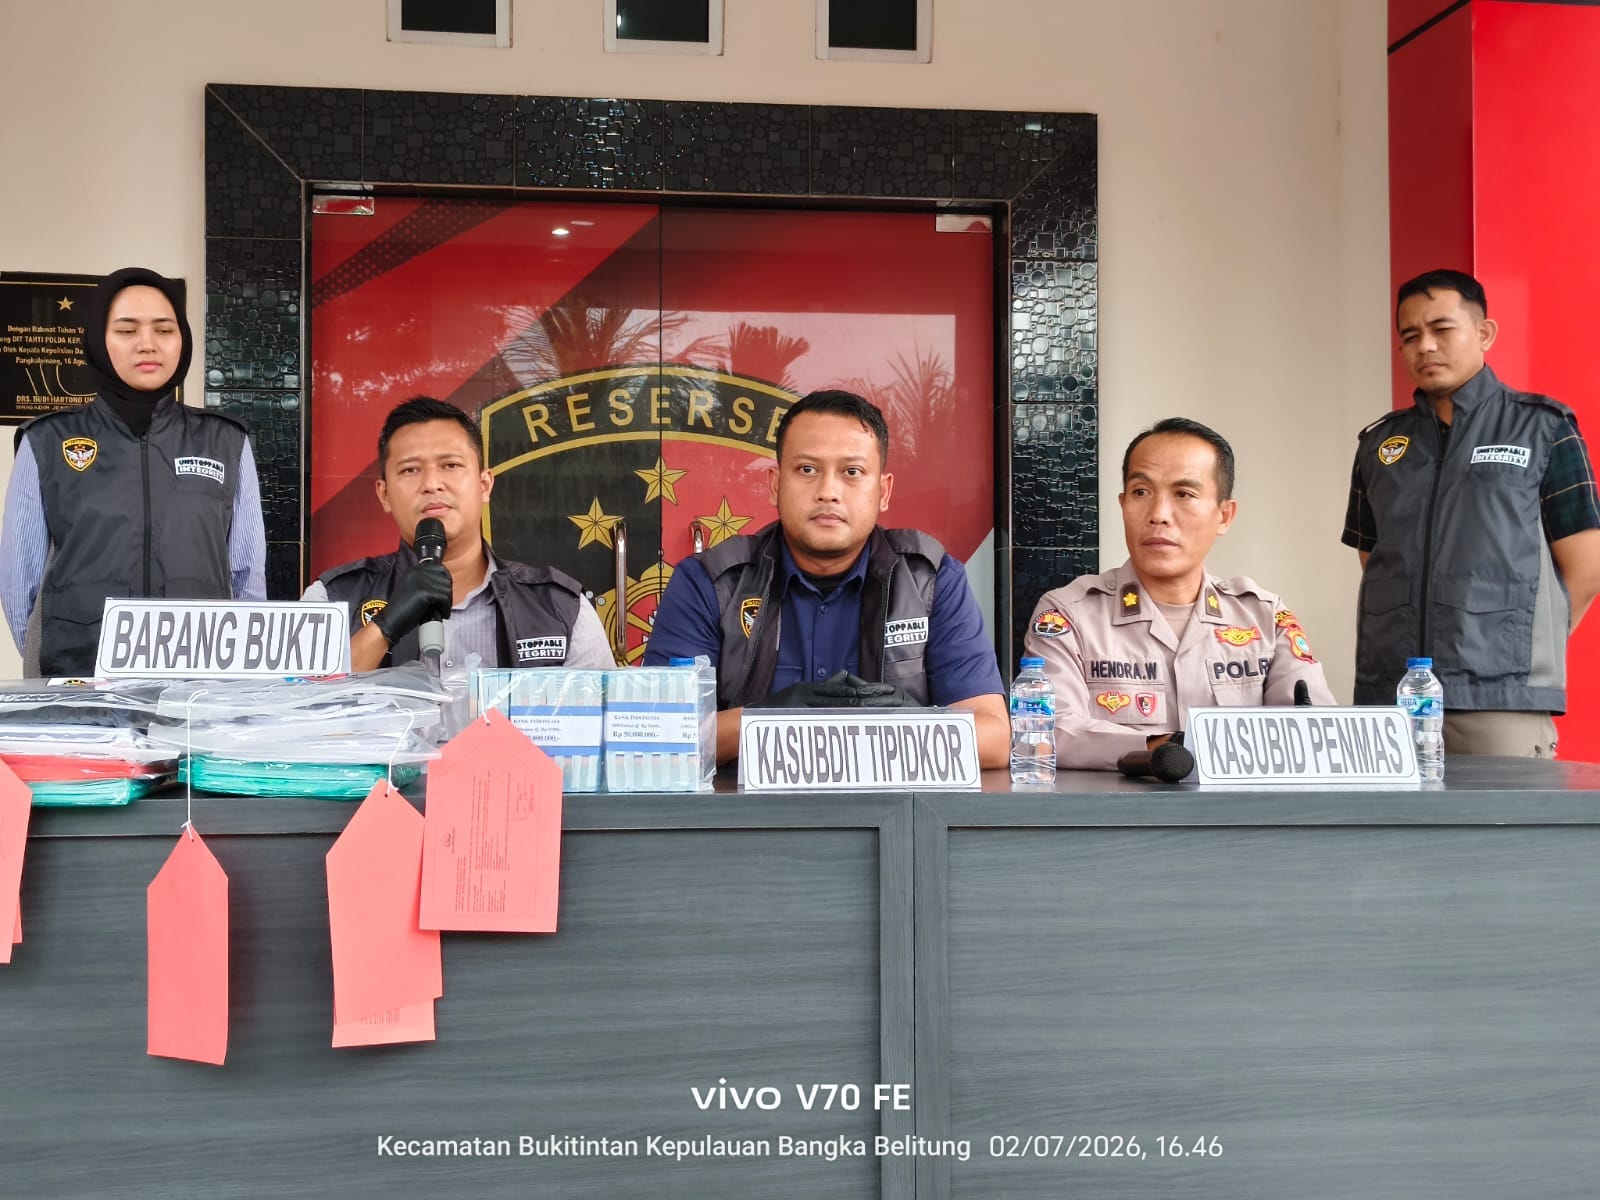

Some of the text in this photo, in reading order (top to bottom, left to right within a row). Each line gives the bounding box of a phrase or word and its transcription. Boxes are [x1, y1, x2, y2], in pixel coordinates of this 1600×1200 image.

[111, 610, 333, 670] BARANG BUKTI
[1090, 659, 1157, 680] HENDRA.W
[756, 724, 967, 784] KASUBDIT TIPIDKOR
[1203, 716, 1404, 775] KASUBID PENMAS
